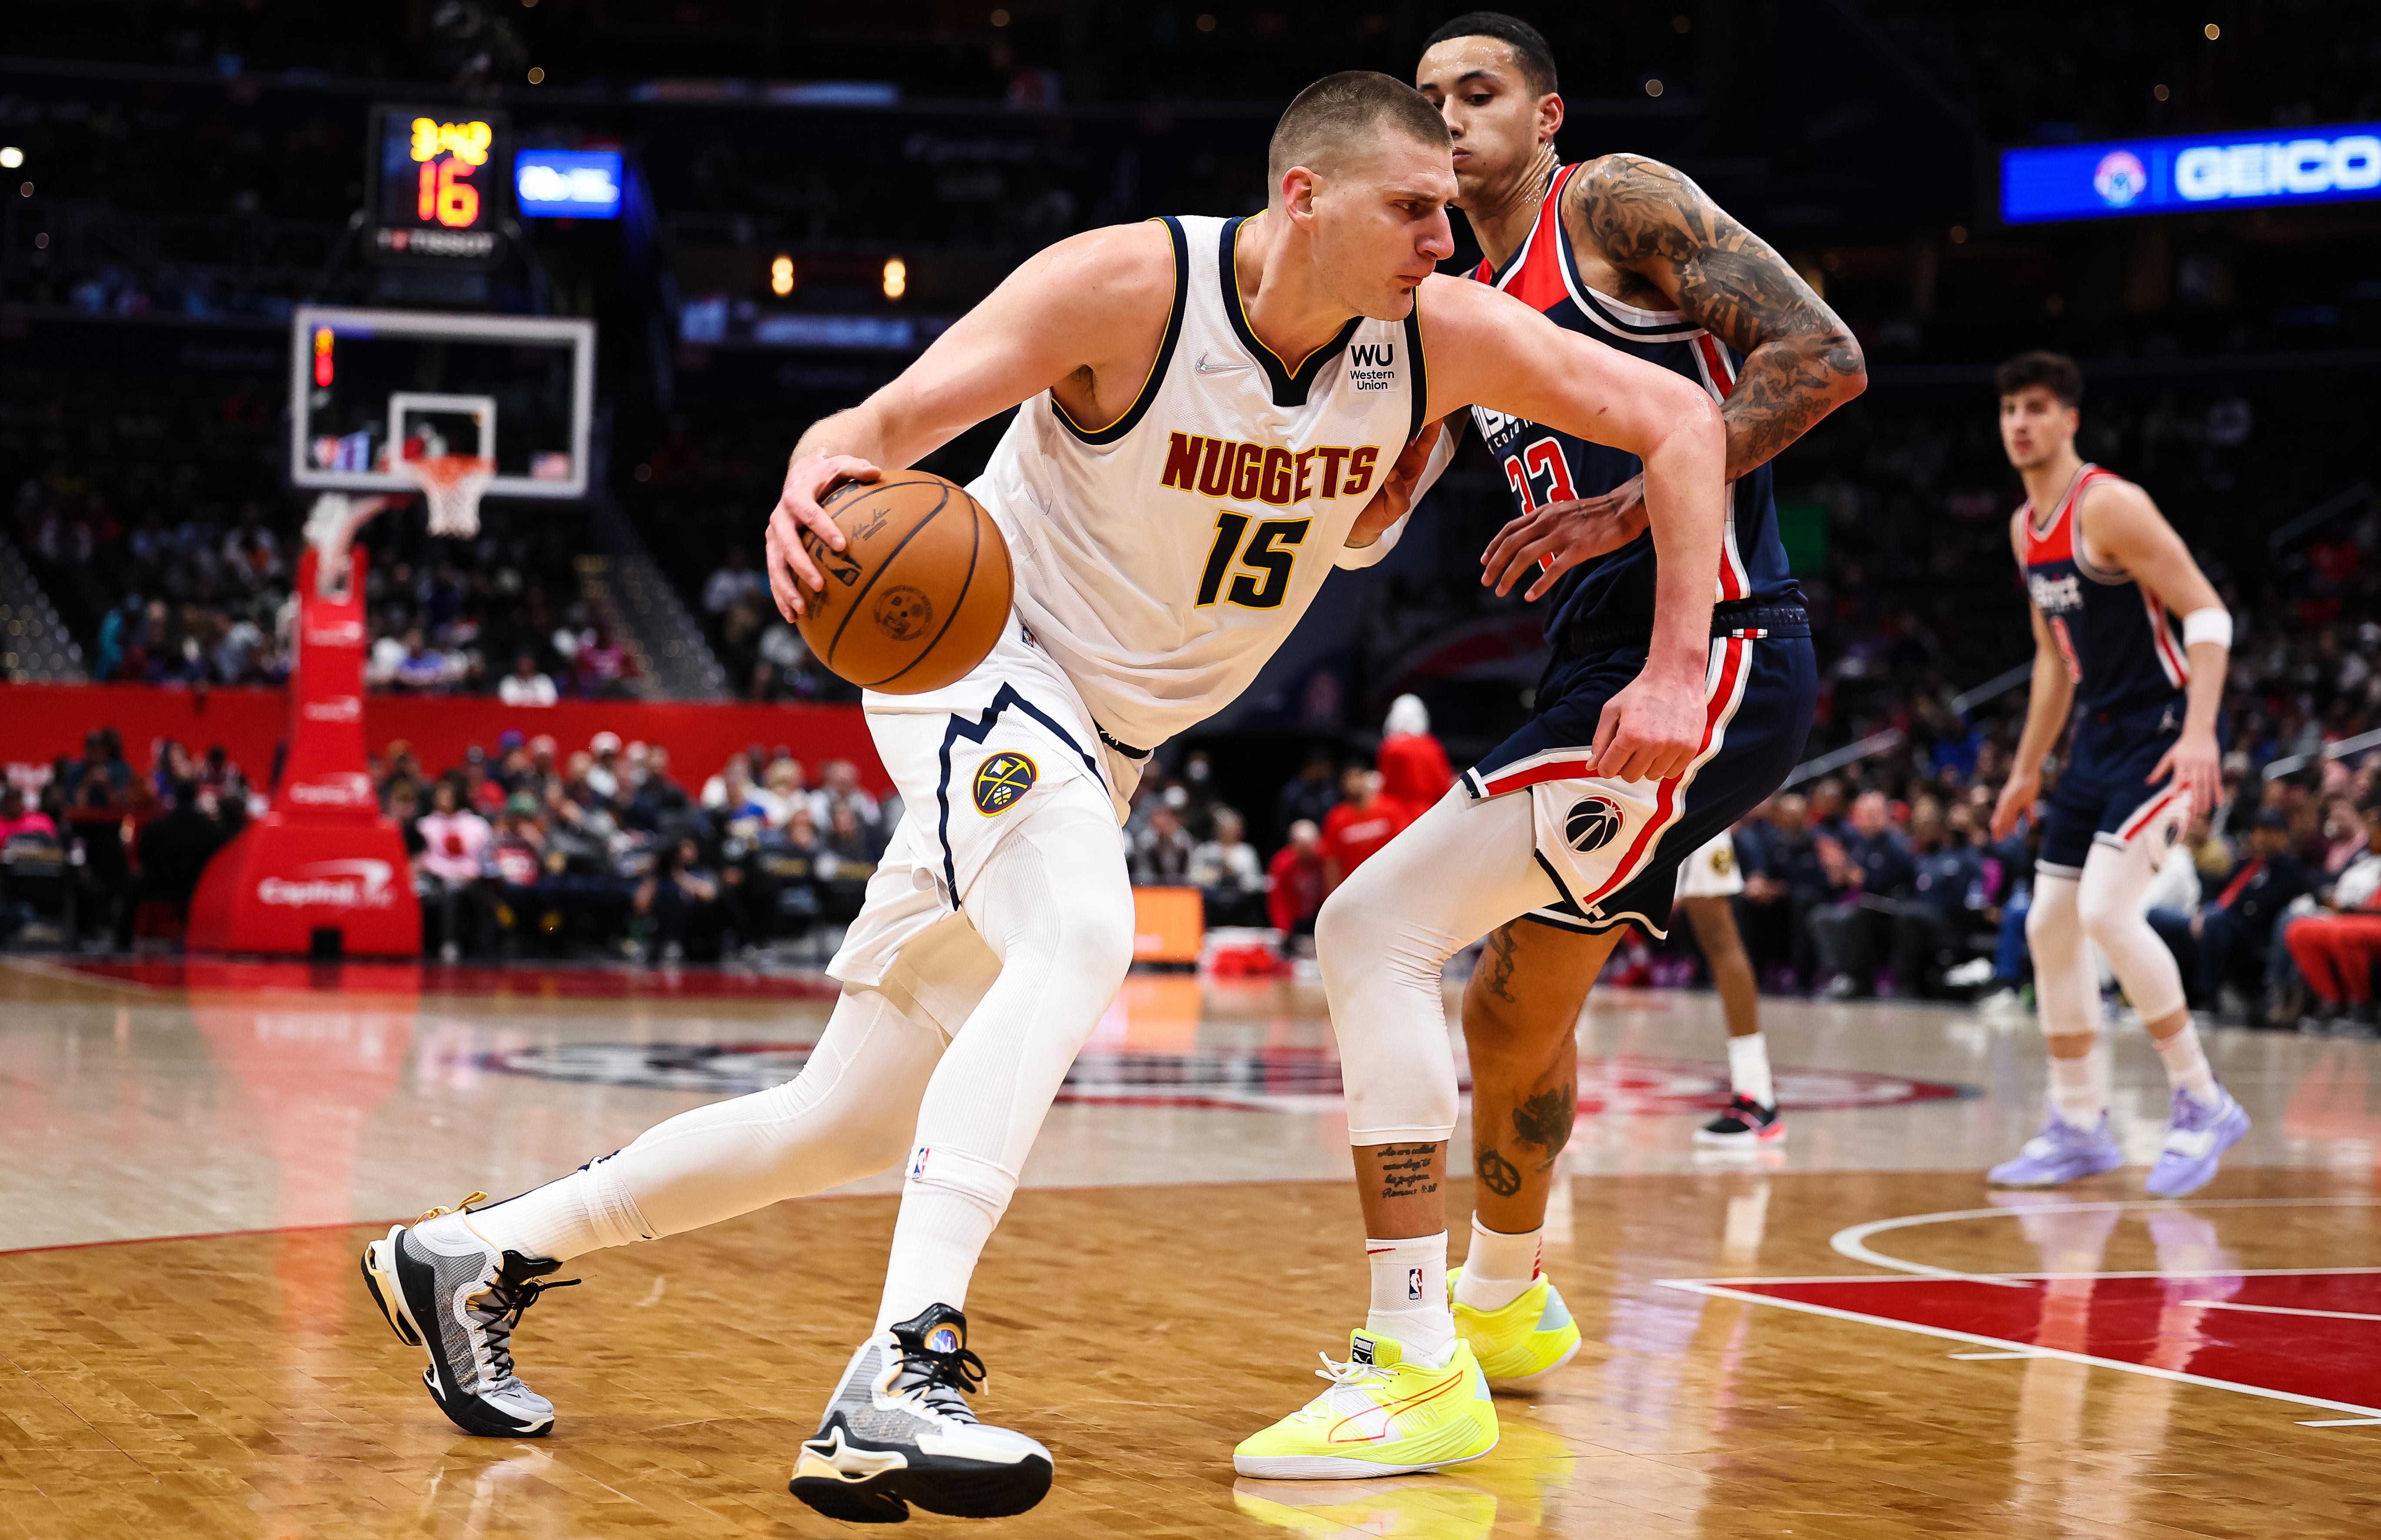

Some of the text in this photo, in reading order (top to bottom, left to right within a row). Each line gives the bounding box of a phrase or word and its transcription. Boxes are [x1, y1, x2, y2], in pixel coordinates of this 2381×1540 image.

[419, 157, 479, 226] 16
[1350, 370, 1395, 380] Western
[1351, 343, 1393, 367] WU
[1357, 380, 1388, 390] Union
[1160, 430, 1381, 506] NUGGETS
[1194, 510, 1313, 610] 15
